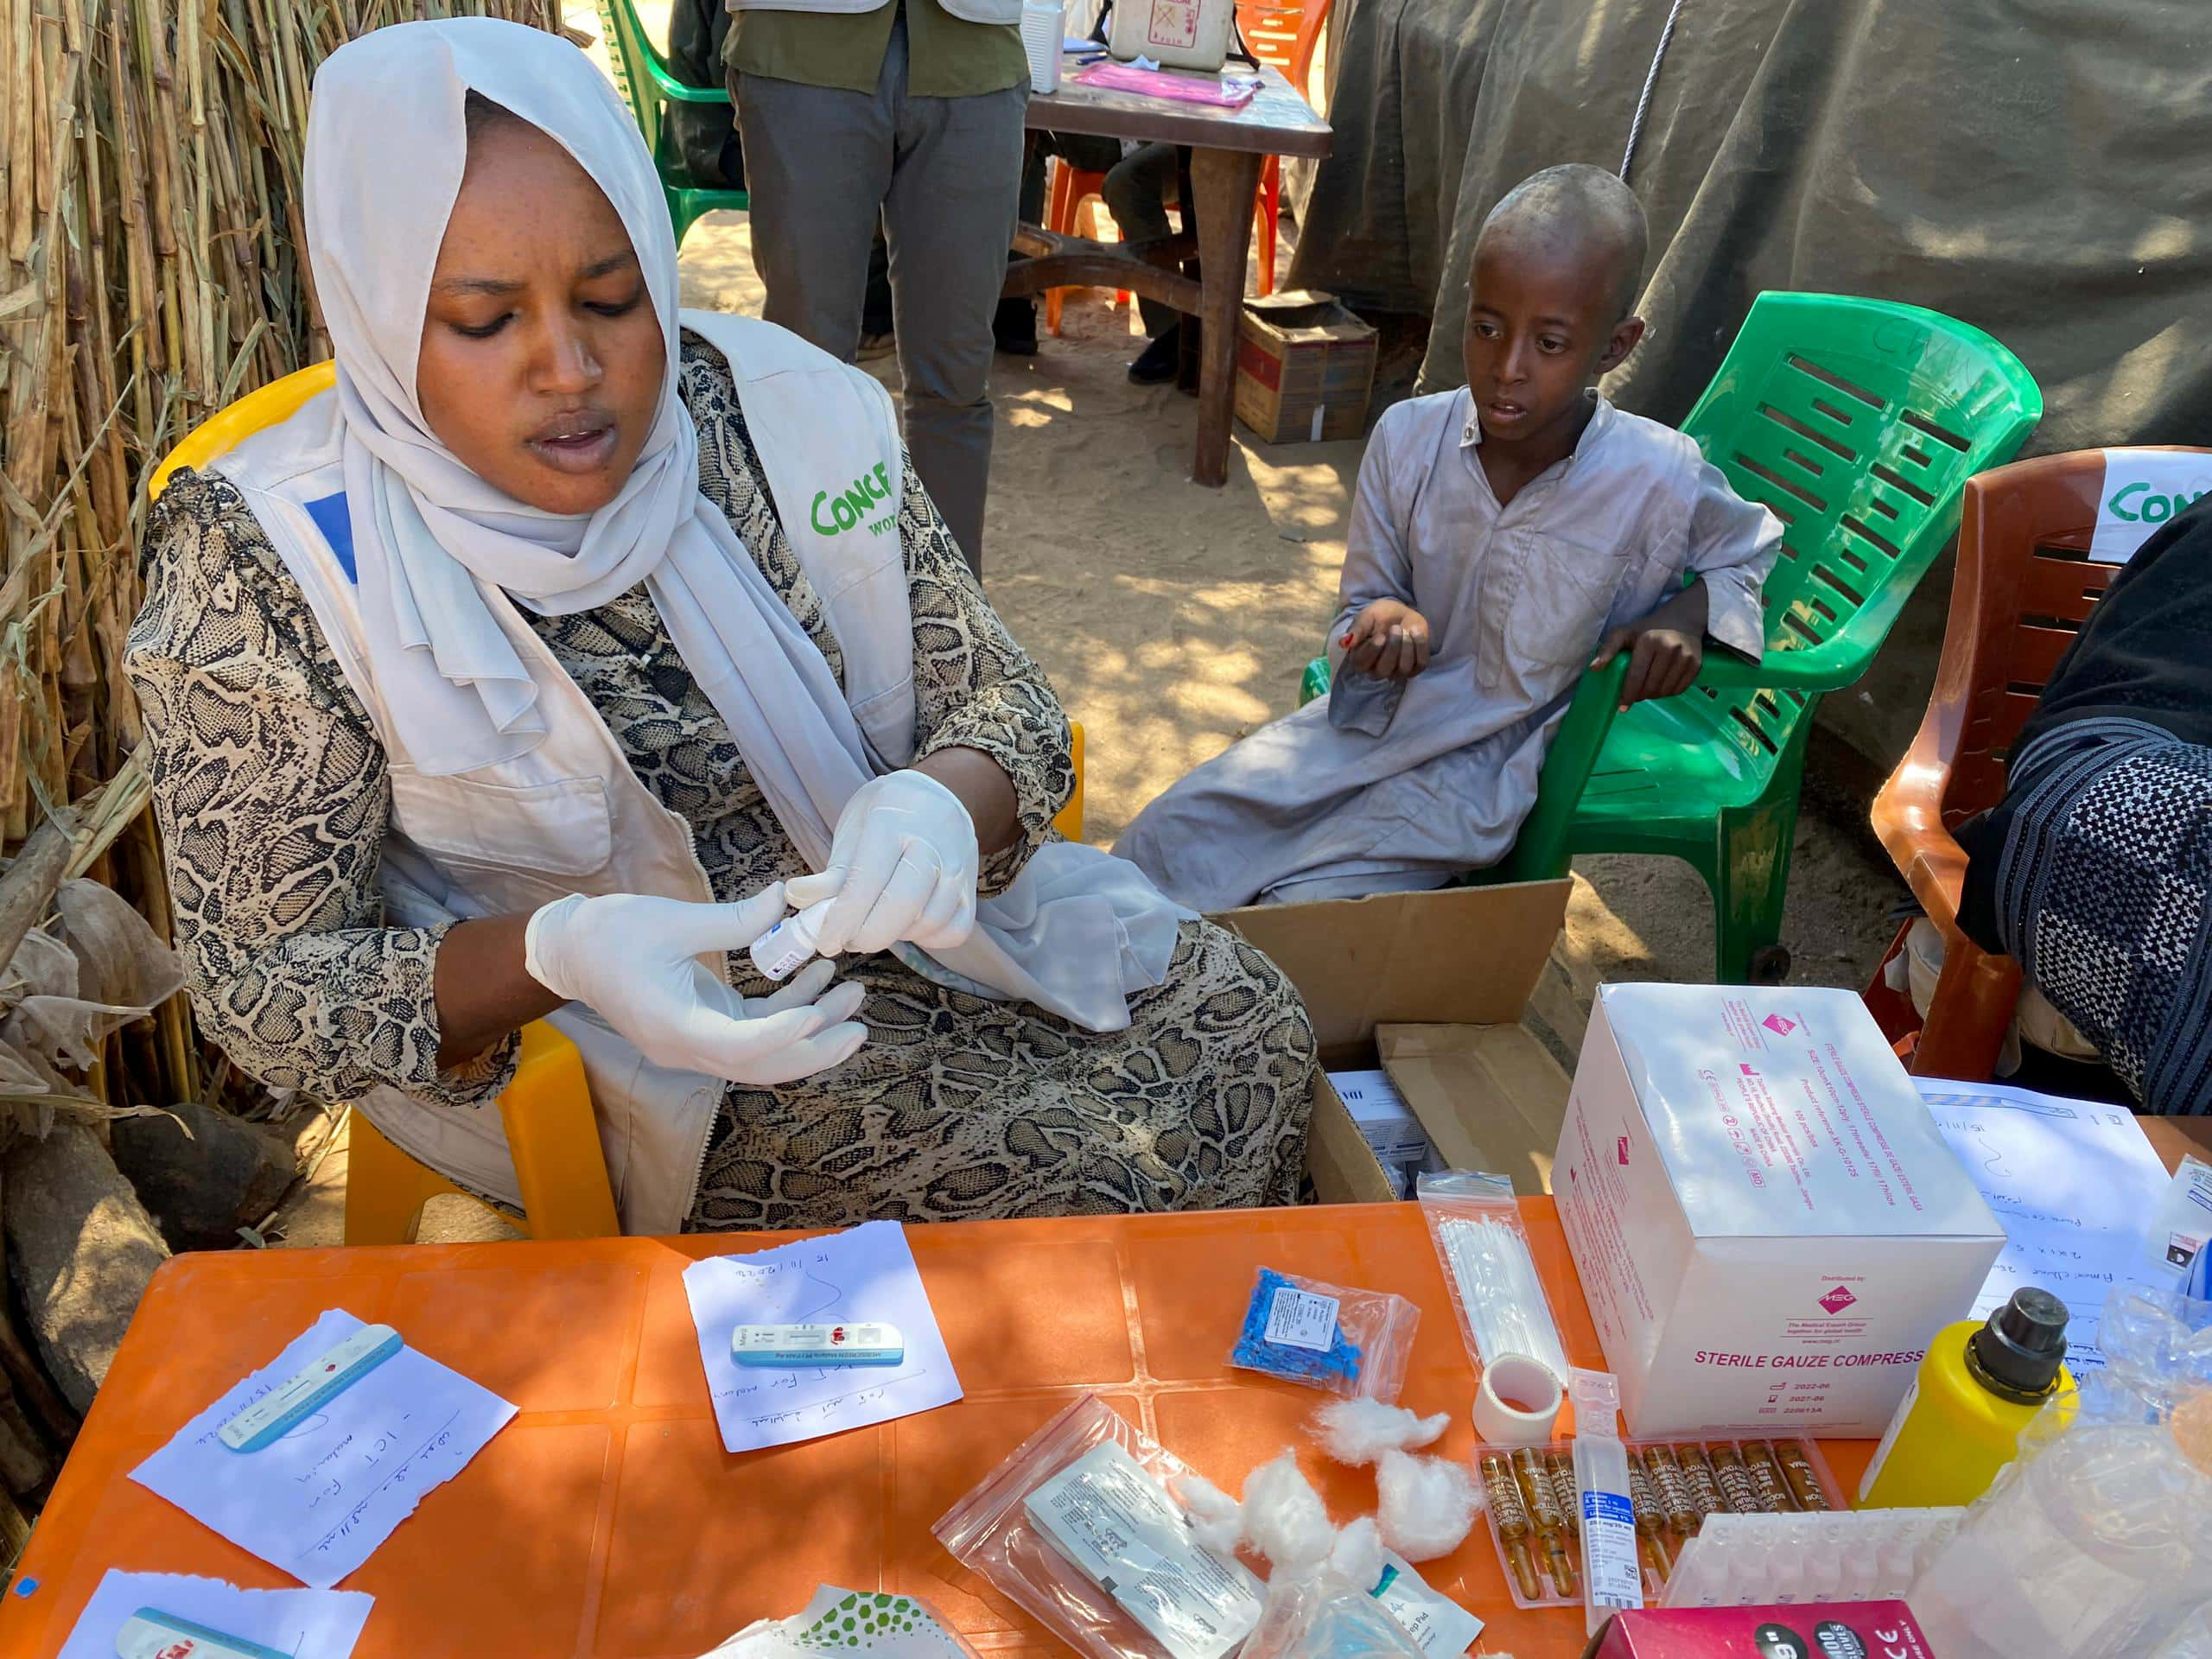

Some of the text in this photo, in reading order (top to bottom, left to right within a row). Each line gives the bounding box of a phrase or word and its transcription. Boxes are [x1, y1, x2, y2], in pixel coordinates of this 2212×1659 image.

[1694, 1350, 1926, 1368] STERILE GAUZE COMPRESS
